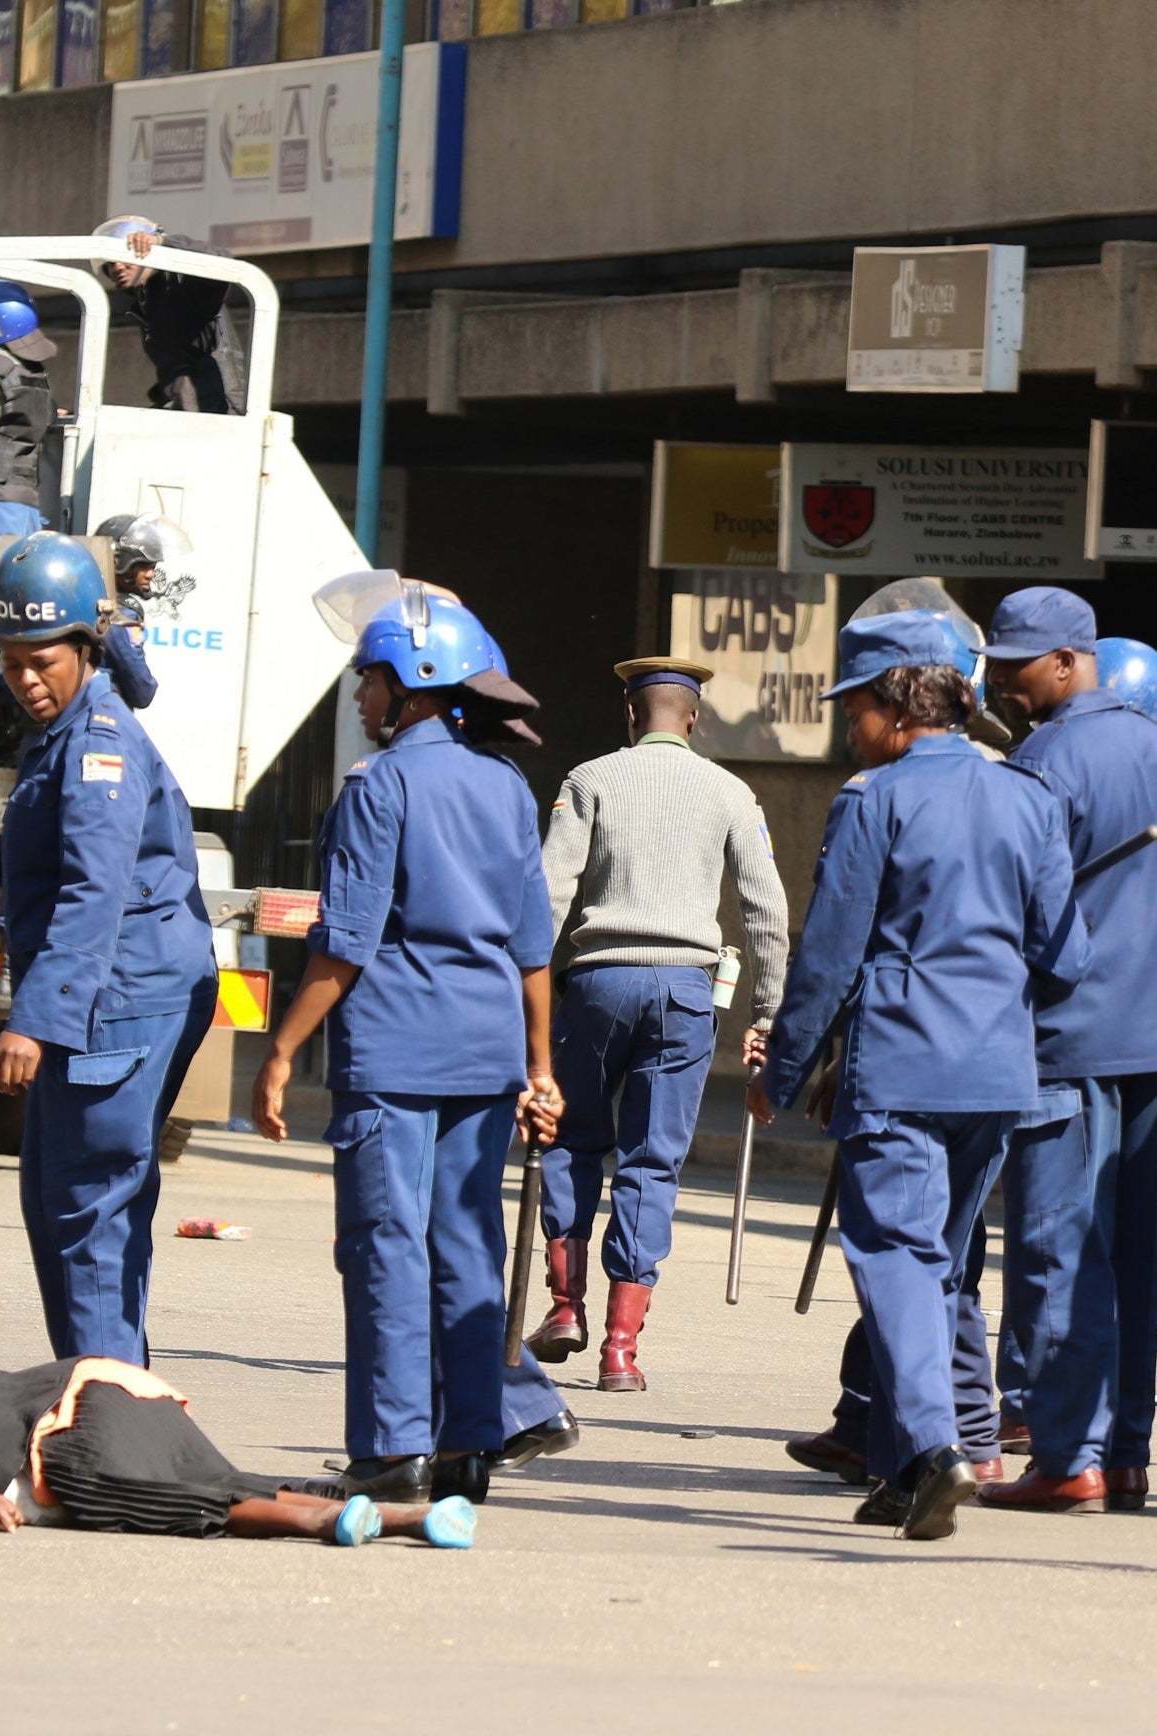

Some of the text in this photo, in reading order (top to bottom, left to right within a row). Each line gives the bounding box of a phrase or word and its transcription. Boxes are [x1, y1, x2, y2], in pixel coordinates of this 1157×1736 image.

[877, 456, 1089, 480] SOLUSI UNIVERSITY
[903, 512, 923, 523] 7th
[927, 513, 959, 523] Floor
[971, 514, 1006, 524] CABS
[1011, 515, 1064, 525] CENTRE
[975, 529, 1042, 540] Zimbabwe
[914, 551, 1060, 568] www.solusi.ac.zw
[701, 574, 796, 652] CABS
[758, 672, 825, 724] CENTRE
